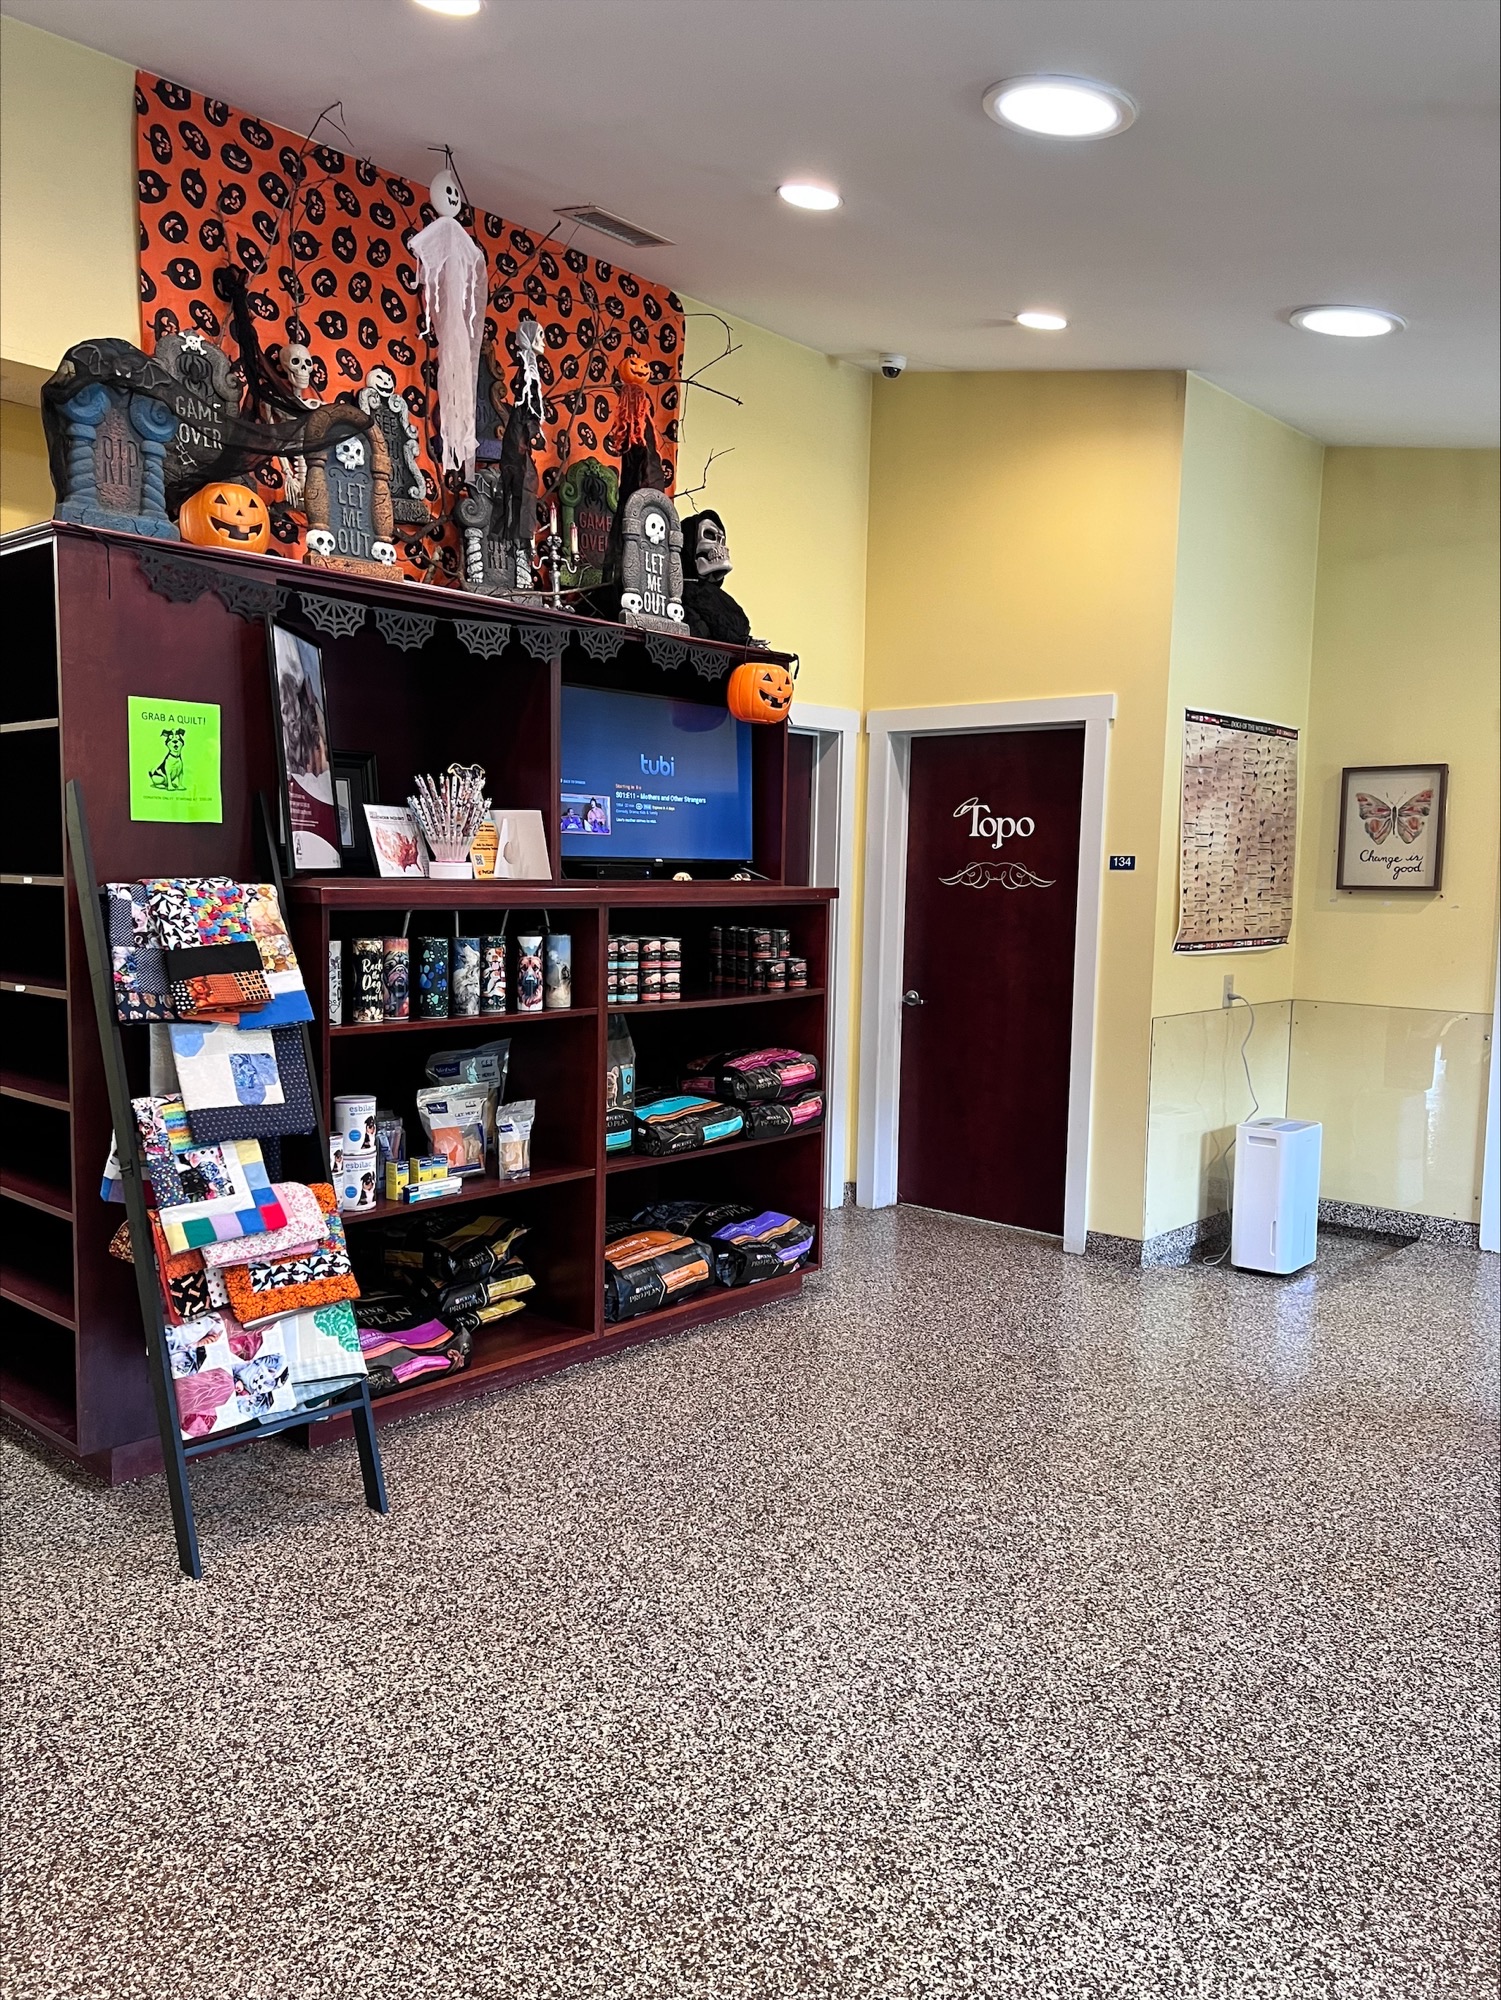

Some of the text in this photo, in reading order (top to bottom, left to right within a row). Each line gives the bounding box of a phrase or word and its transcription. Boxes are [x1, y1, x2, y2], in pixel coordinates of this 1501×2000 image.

[176, 396, 222, 424] GAME
[179, 423, 223, 450] OVER
[102, 436, 139, 488] RIP
[337, 480, 366, 509] LET
[342, 508, 363, 531] ME
[338, 529, 371, 558] OUT
[645, 551, 665, 575] LET
[647, 574, 663, 593] ME
[643, 592, 667, 616] OUT
[141, 711, 206, 725] GRAB A QUILT!
[640, 753, 675, 777] tubi
[958, 802, 1036, 850] Topo
[1113, 857, 1131, 867] 134
[1359, 849, 1424, 870] Change is
[1392, 861, 1424, 880] good.
[362, 1306, 413, 1327] PLAN
